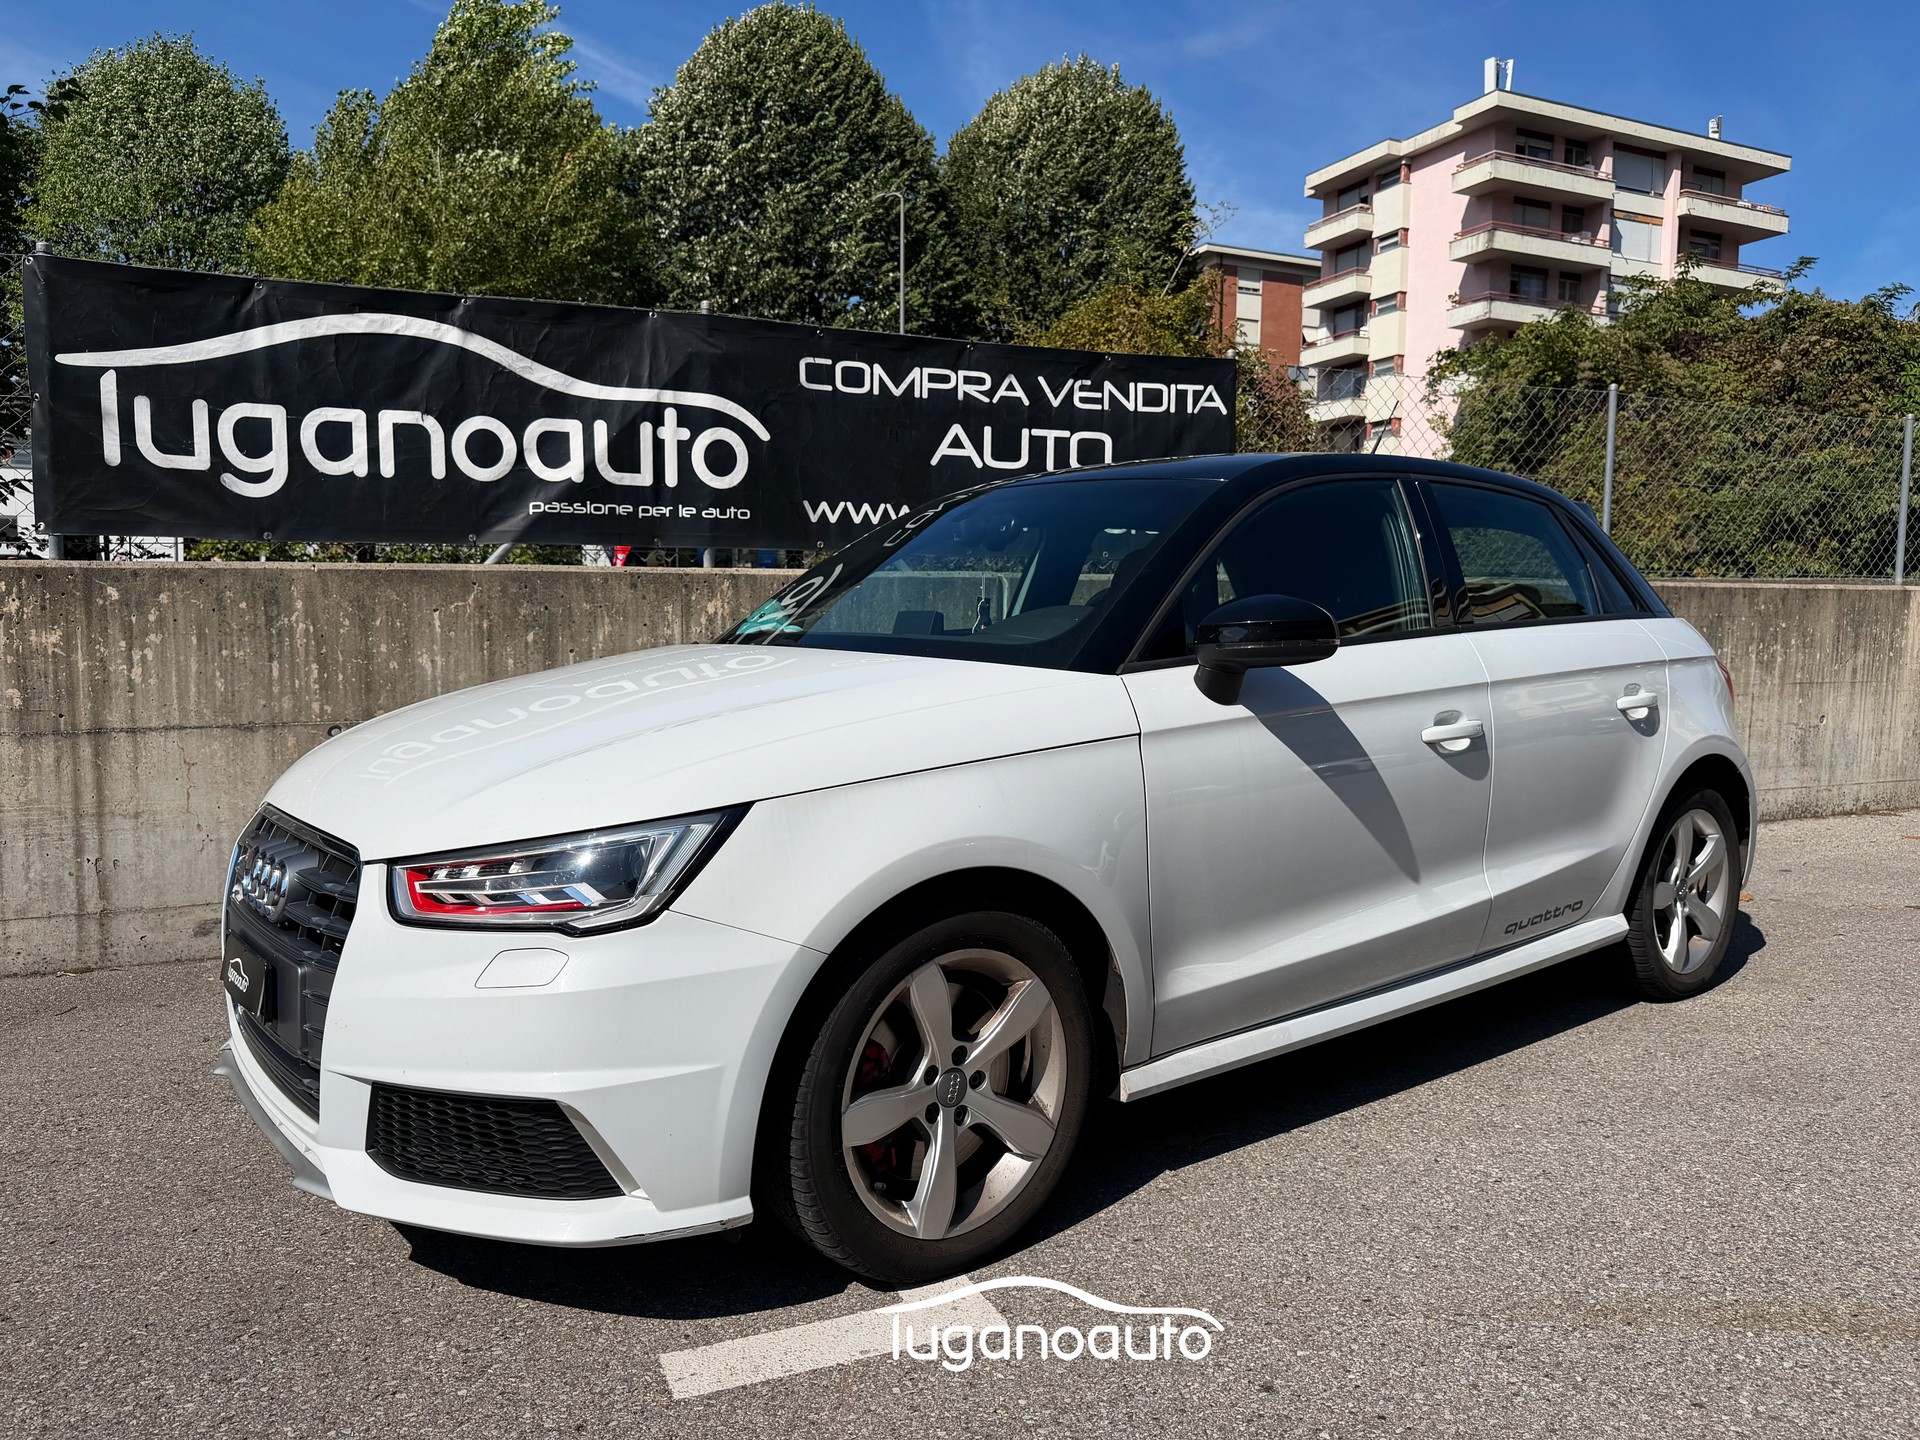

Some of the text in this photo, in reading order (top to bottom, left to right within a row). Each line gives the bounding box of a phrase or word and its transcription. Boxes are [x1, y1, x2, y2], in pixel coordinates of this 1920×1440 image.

[800, 357, 1227, 414] COMPRA VENDITA
[100, 370, 749, 497] luganoauto
[930, 423, 1112, 471] AUTO
[529, 501, 750, 519] passione per le auto
[1504, 900, 1583, 935] quattro
